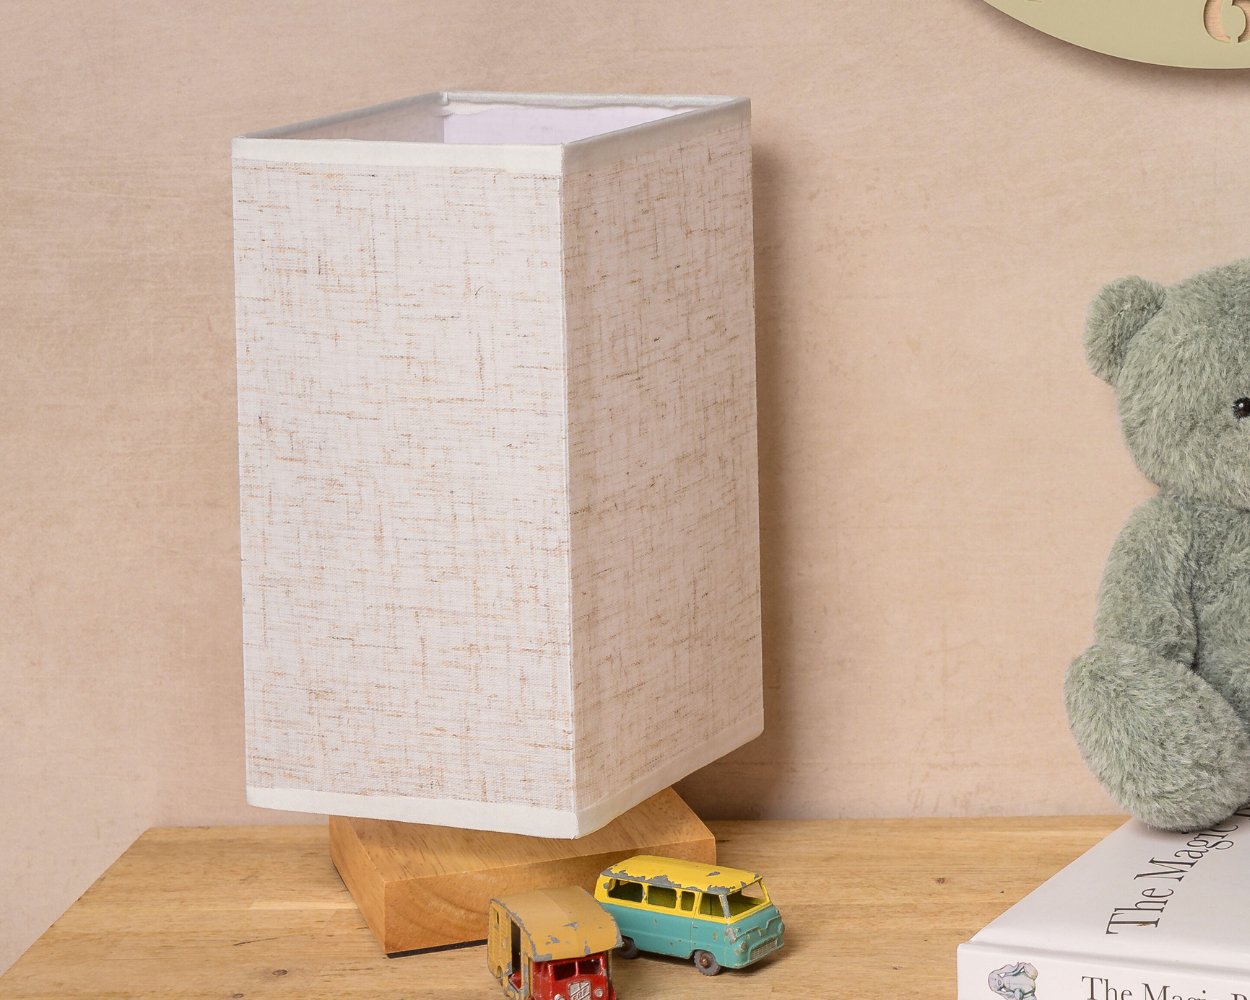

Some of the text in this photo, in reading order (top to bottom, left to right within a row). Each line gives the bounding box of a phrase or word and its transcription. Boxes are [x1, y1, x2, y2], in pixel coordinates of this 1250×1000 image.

[1133, 823, 1239, 882] Magic
[1105, 887, 1175, 935] The
[1081, 975, 1133, 1000] The
